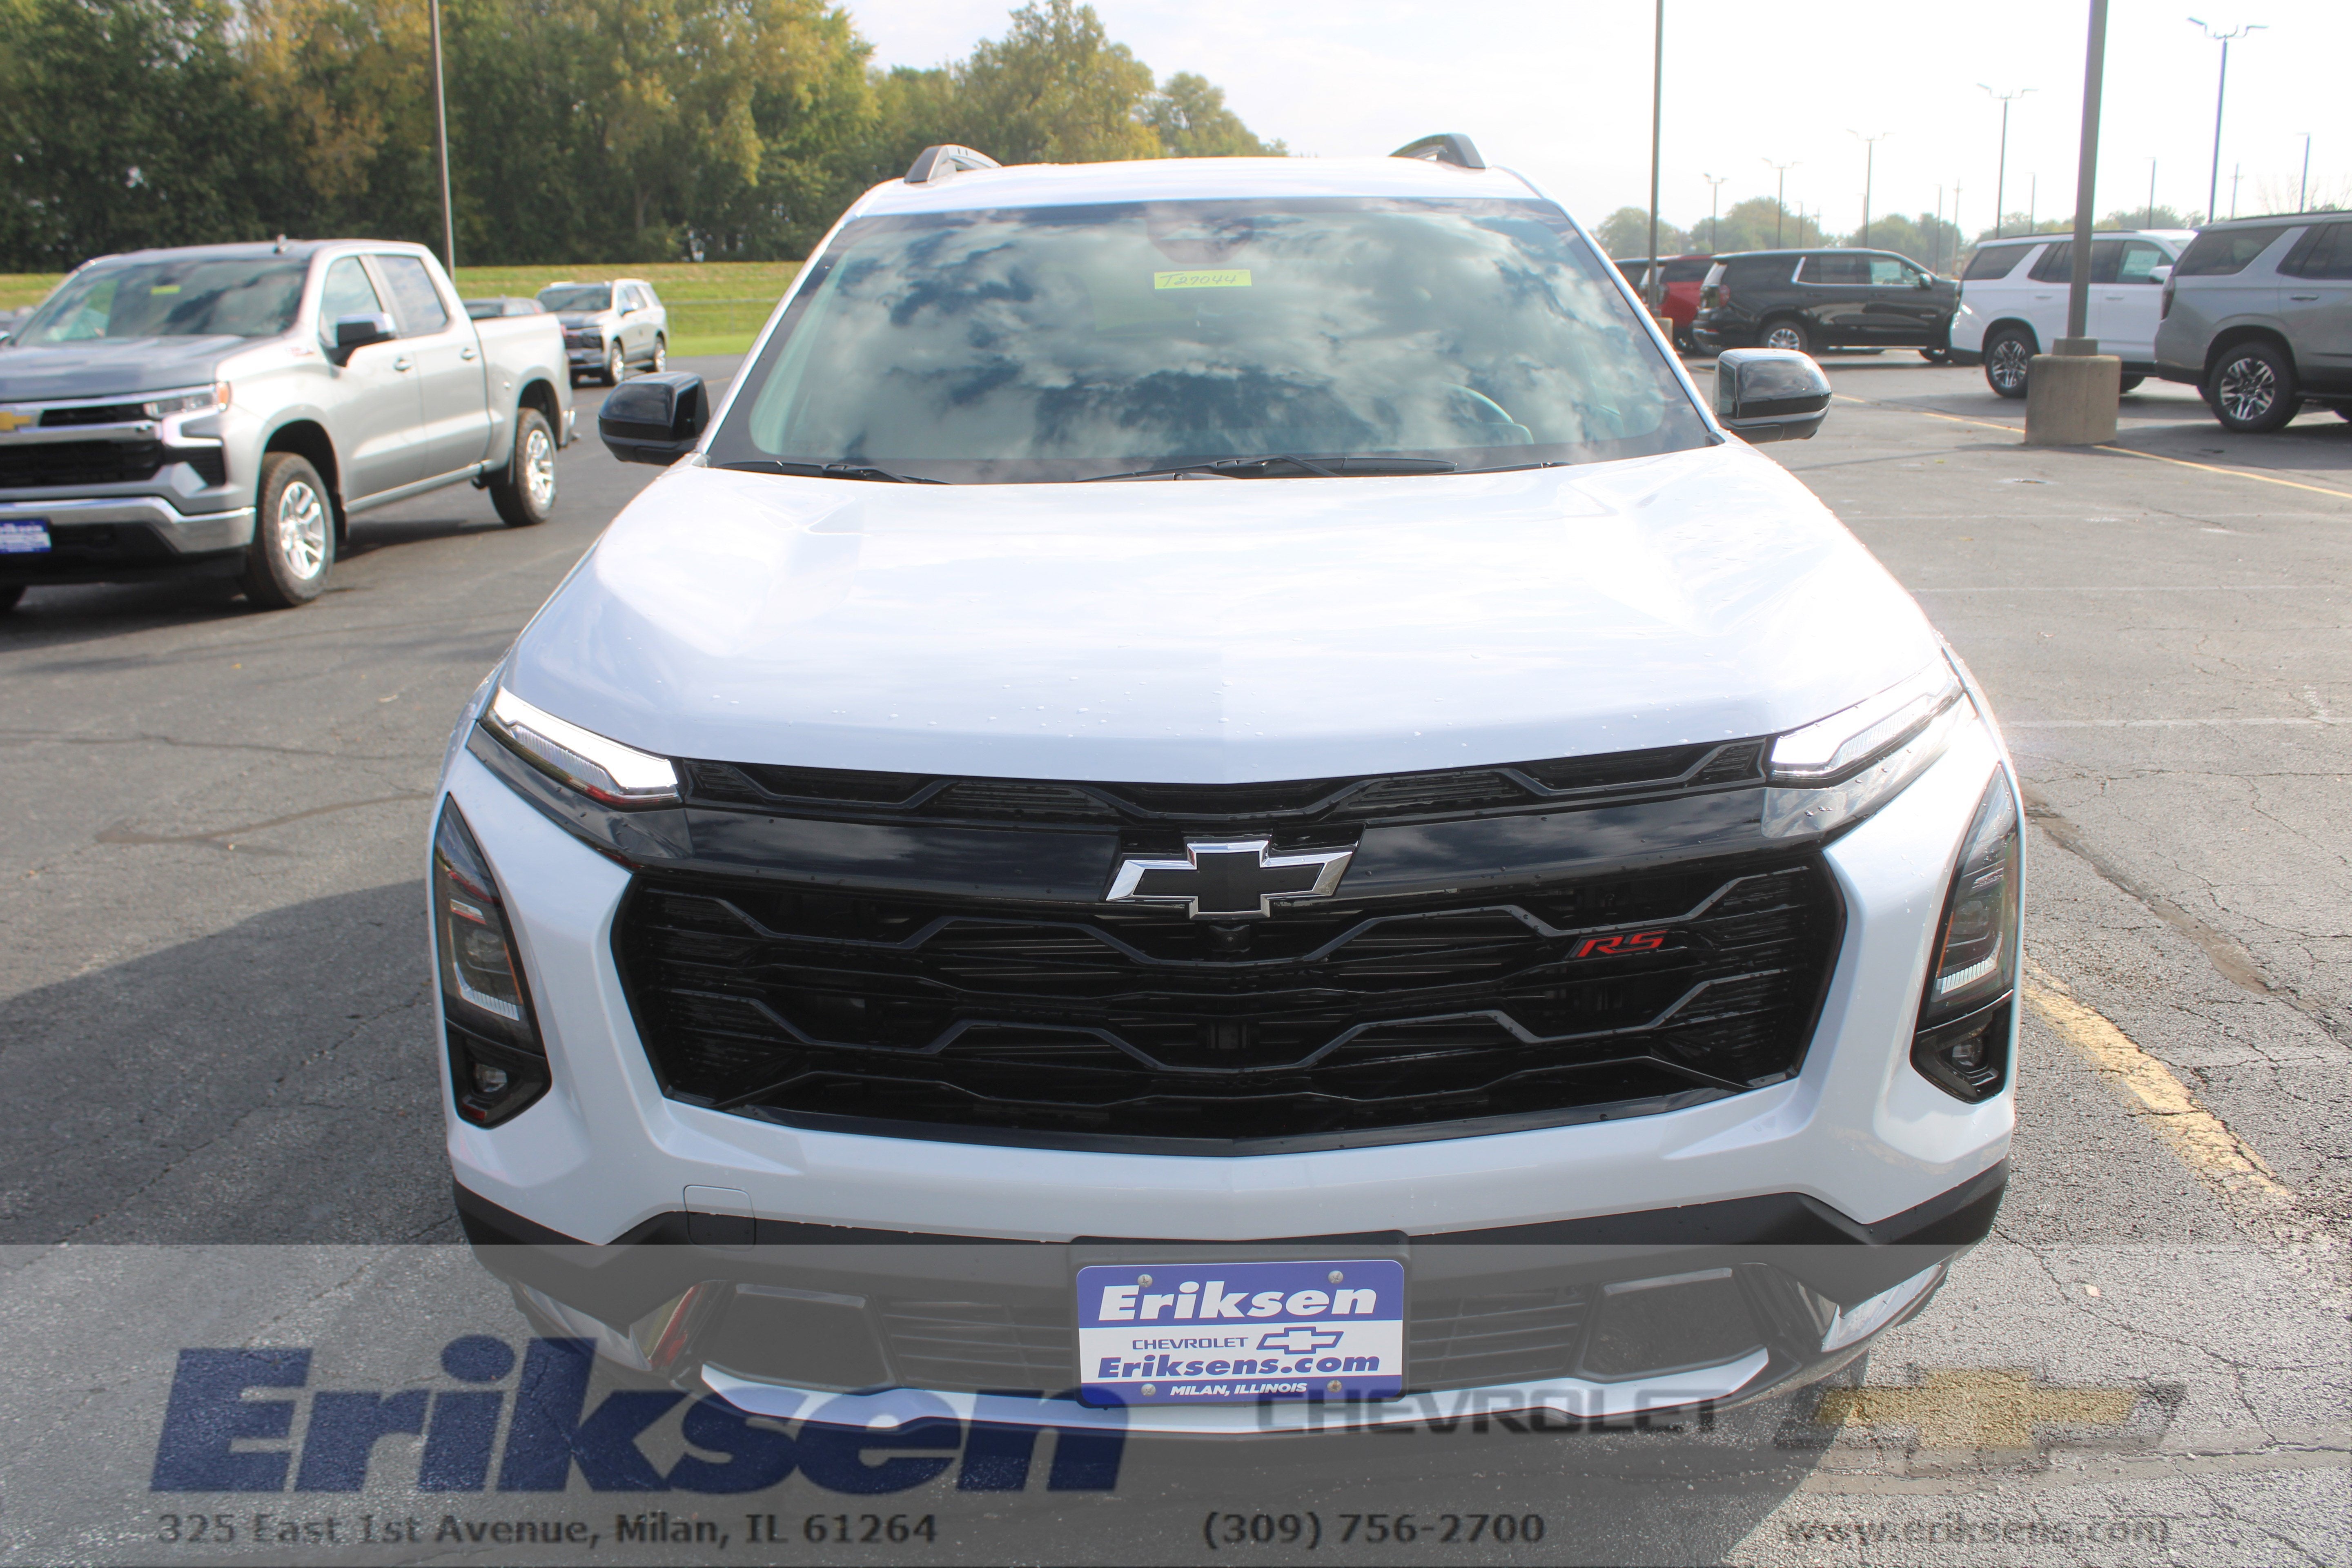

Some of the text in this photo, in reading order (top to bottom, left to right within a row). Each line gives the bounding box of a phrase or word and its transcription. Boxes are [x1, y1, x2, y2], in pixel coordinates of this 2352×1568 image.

[1569, 930, 1669, 958] RS
[1098, 1281, 1377, 1322] Eriksen
[1132, 1336, 1249, 1350] CHEVROLET
[1098, 1354, 1380, 1378] Eriksens.com
[1170, 1382, 1307, 1396] MILAN, ILLINOIS
